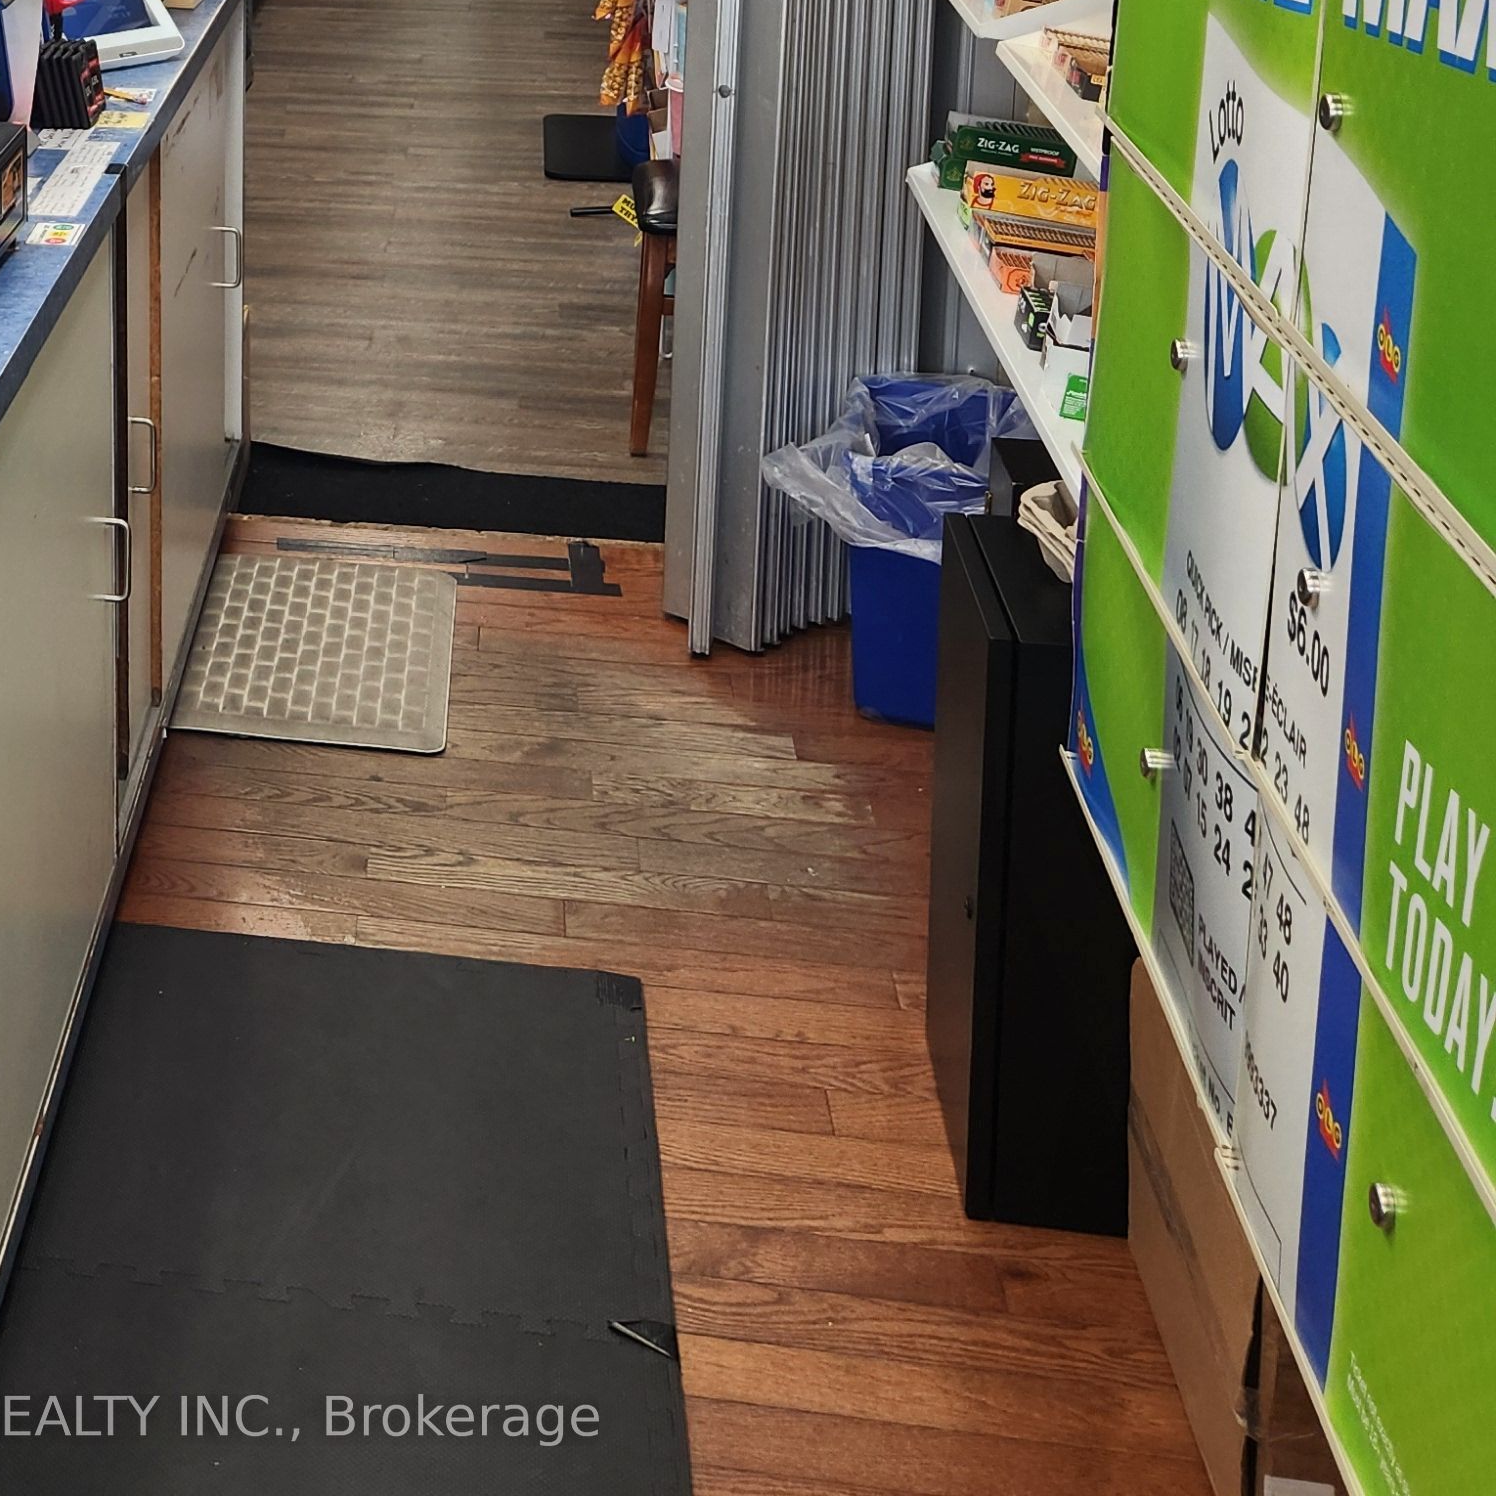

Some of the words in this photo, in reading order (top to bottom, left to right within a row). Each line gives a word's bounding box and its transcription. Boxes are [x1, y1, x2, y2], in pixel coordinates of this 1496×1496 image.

[977, 136, 1021, 155] ZIG-ZAG
[1207, 80, 1246, 164] Lotto
[1017, 180, 1097, 212] ZIG-ZAG
[1376, 322, 1402, 373] OLG
[1205, 592, 1222, 649] PICK
[1287, 590, 1330, 697] $6.00
[1217, 680, 1233, 728] 19
[1274, 751, 1289, 805] 23
[1294, 793, 1310, 845] 48
[1344, 727, 1365, 781] OLG
[1215, 770, 1234, 823] 38
[1196, 791, 1208, 838] 15
[1213, 823, 1231, 877] 24
[1394, 740, 1490, 928] PLAY
[1276, 892, 1293, 946] 48
[1197, 912, 1239, 996] PLAYED
[1272, 950, 1290, 1003] 40
[1385, 860, 1496, 1096] TODAY
[1316, 1090, 1342, 1150] OLG
